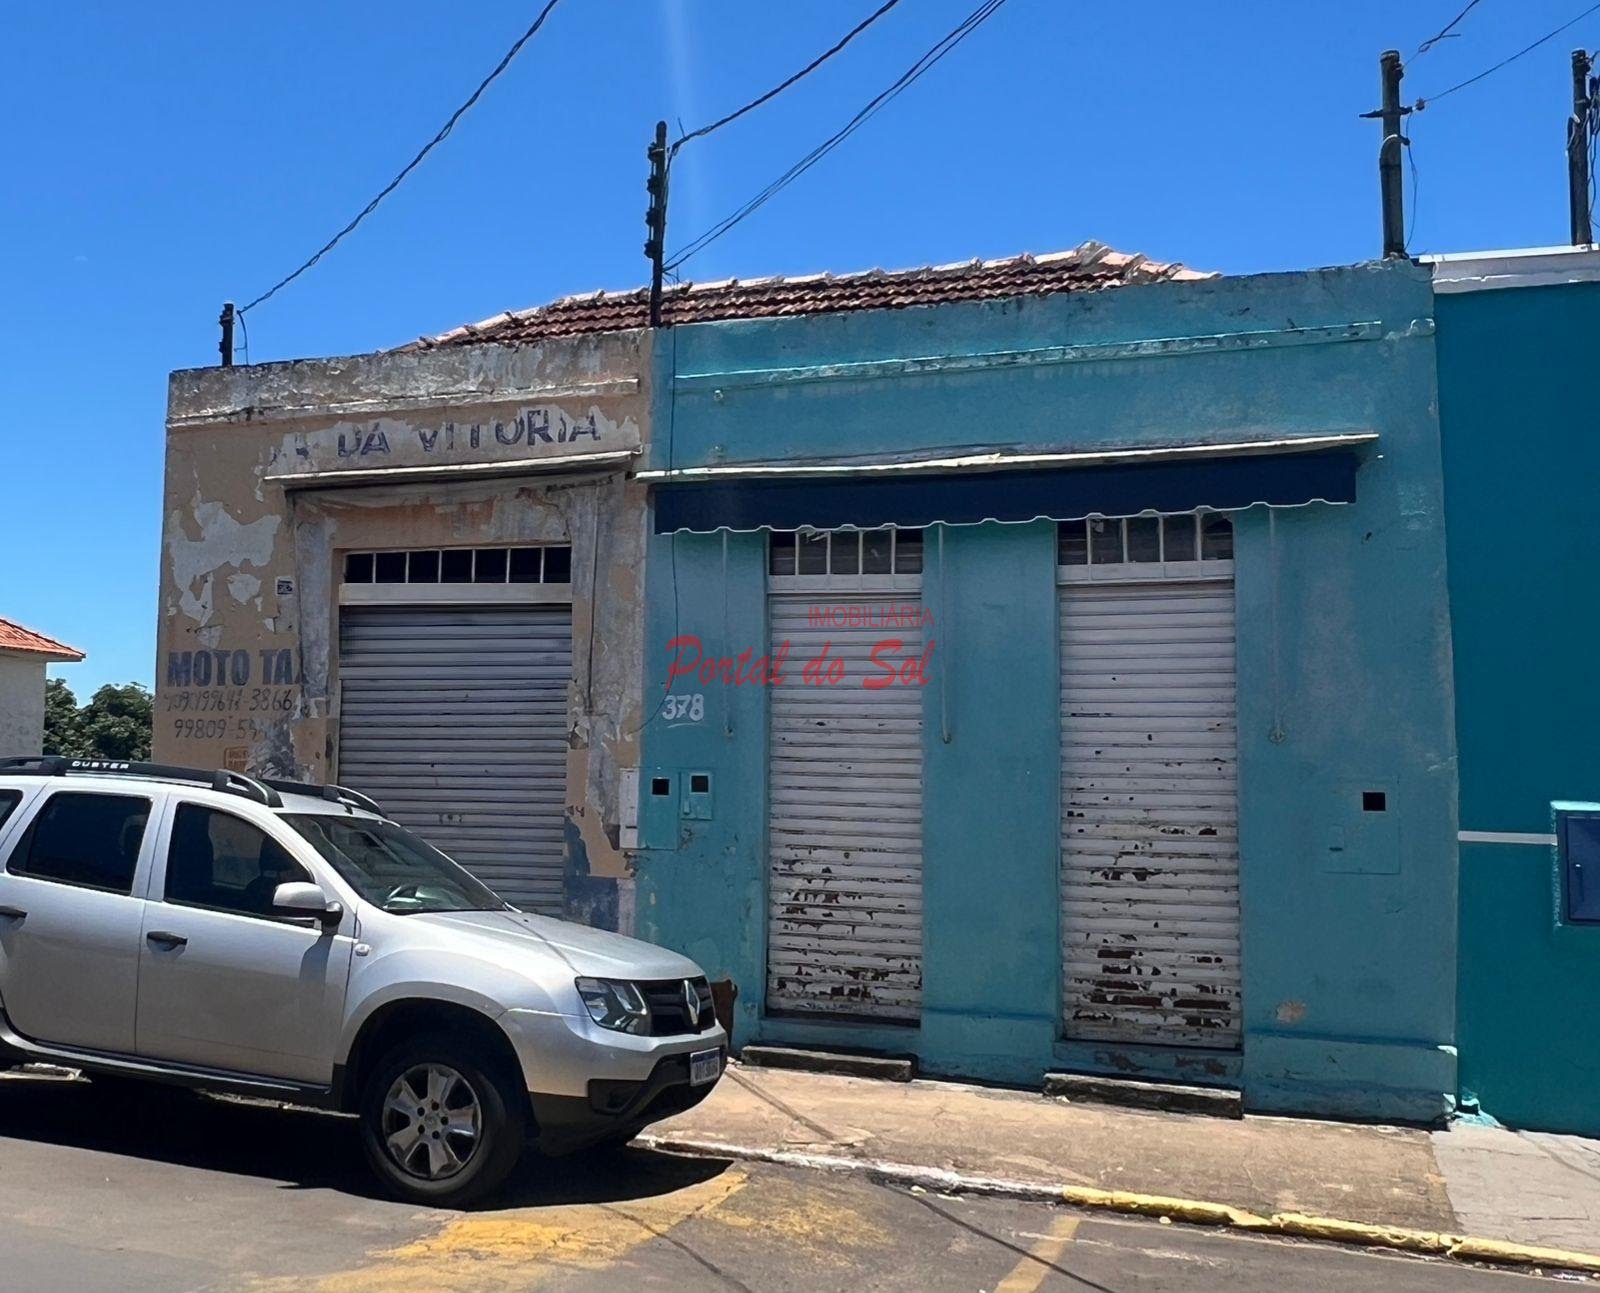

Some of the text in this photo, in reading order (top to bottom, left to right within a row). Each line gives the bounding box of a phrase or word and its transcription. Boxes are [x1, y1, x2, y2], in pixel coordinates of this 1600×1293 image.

[167, 649, 250, 687] MOTO
[662, 694, 705, 721] 378
[71, 760, 130, 769] DUSTER
